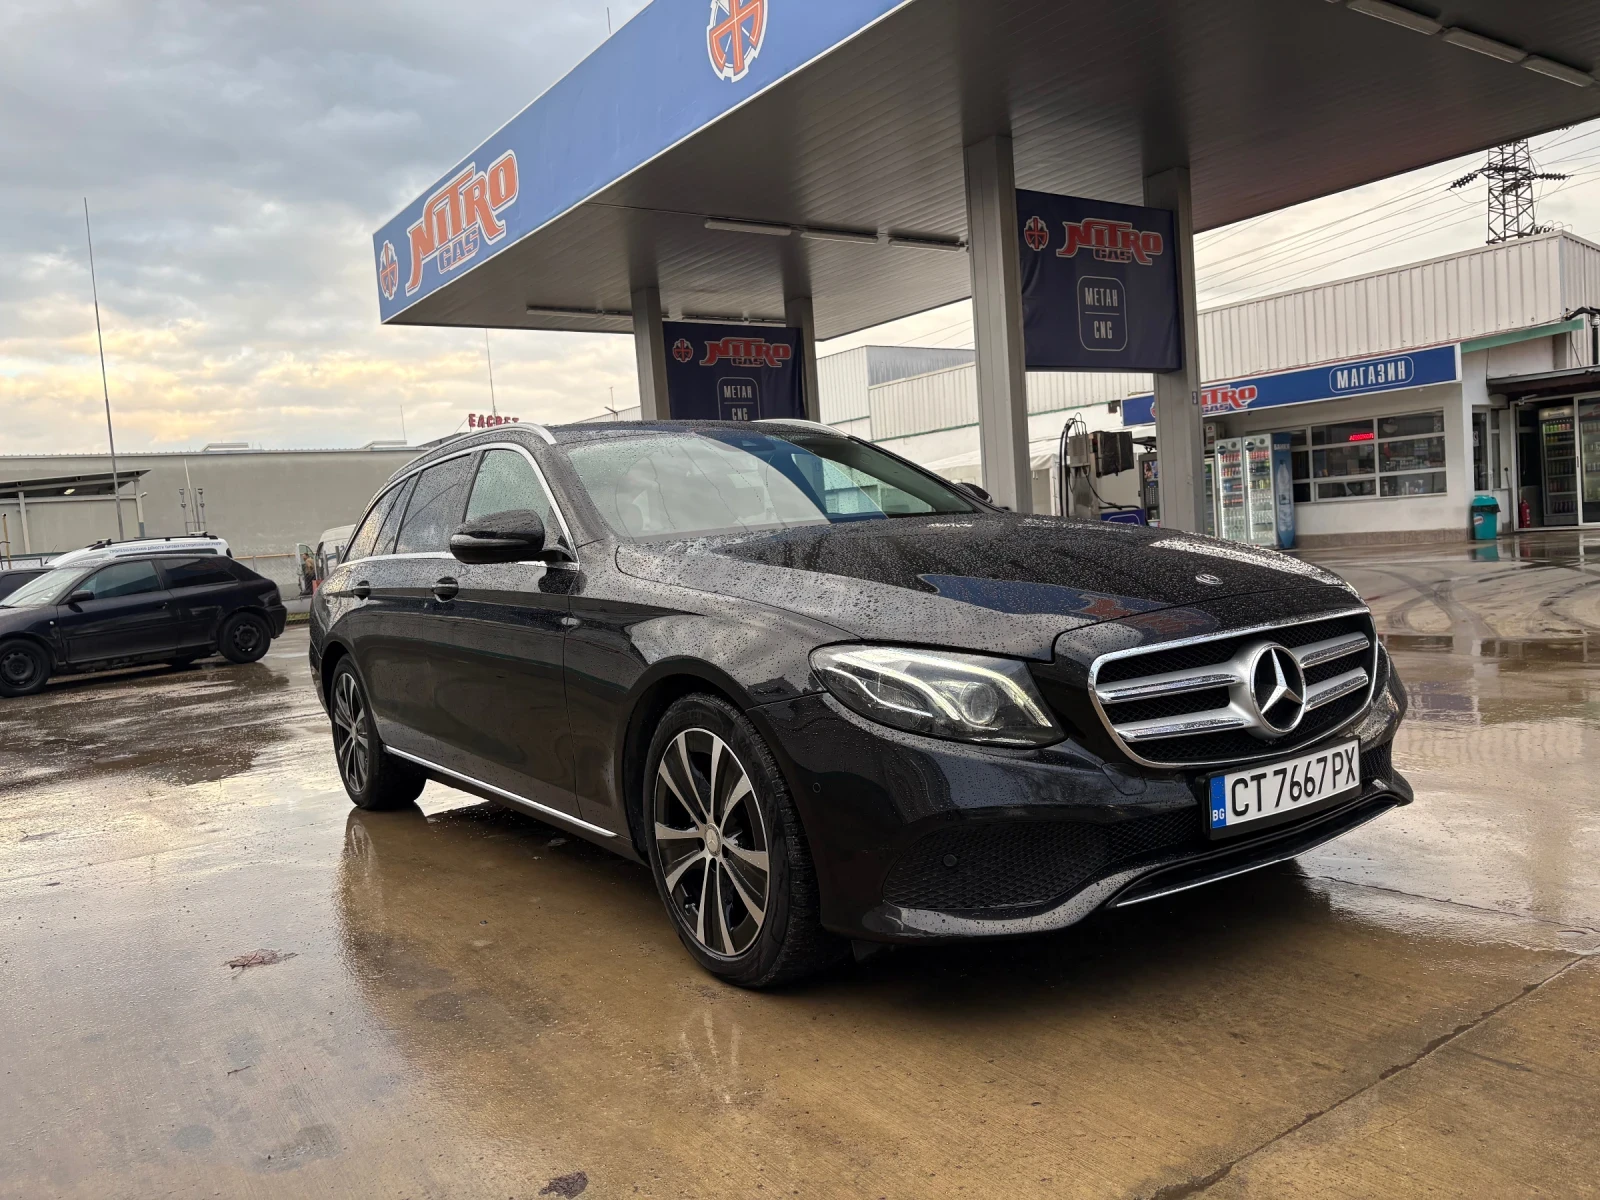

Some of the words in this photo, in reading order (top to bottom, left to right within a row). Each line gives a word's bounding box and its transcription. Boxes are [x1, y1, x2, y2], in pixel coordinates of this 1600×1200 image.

[405, 149, 519, 296] NITRO
[437, 226, 480, 274] GAS
[1056, 217, 1163, 265] NITRO
[1093, 248, 1133, 263] GAS
[1084, 287, 1118, 307] МЕТАН
[1093, 320, 1113, 339] CNG
[699, 337, 791, 367] NITRO
[731, 357, 764, 367] GAS
[1336, 360, 1406, 389] МАГАЗИН
[724, 385, 752, 399] МЕТАН
[1202, 385, 1258, 409] ITRO
[732, 407, 748, 421] CNG
[1212, 808, 1225, 821] BG
